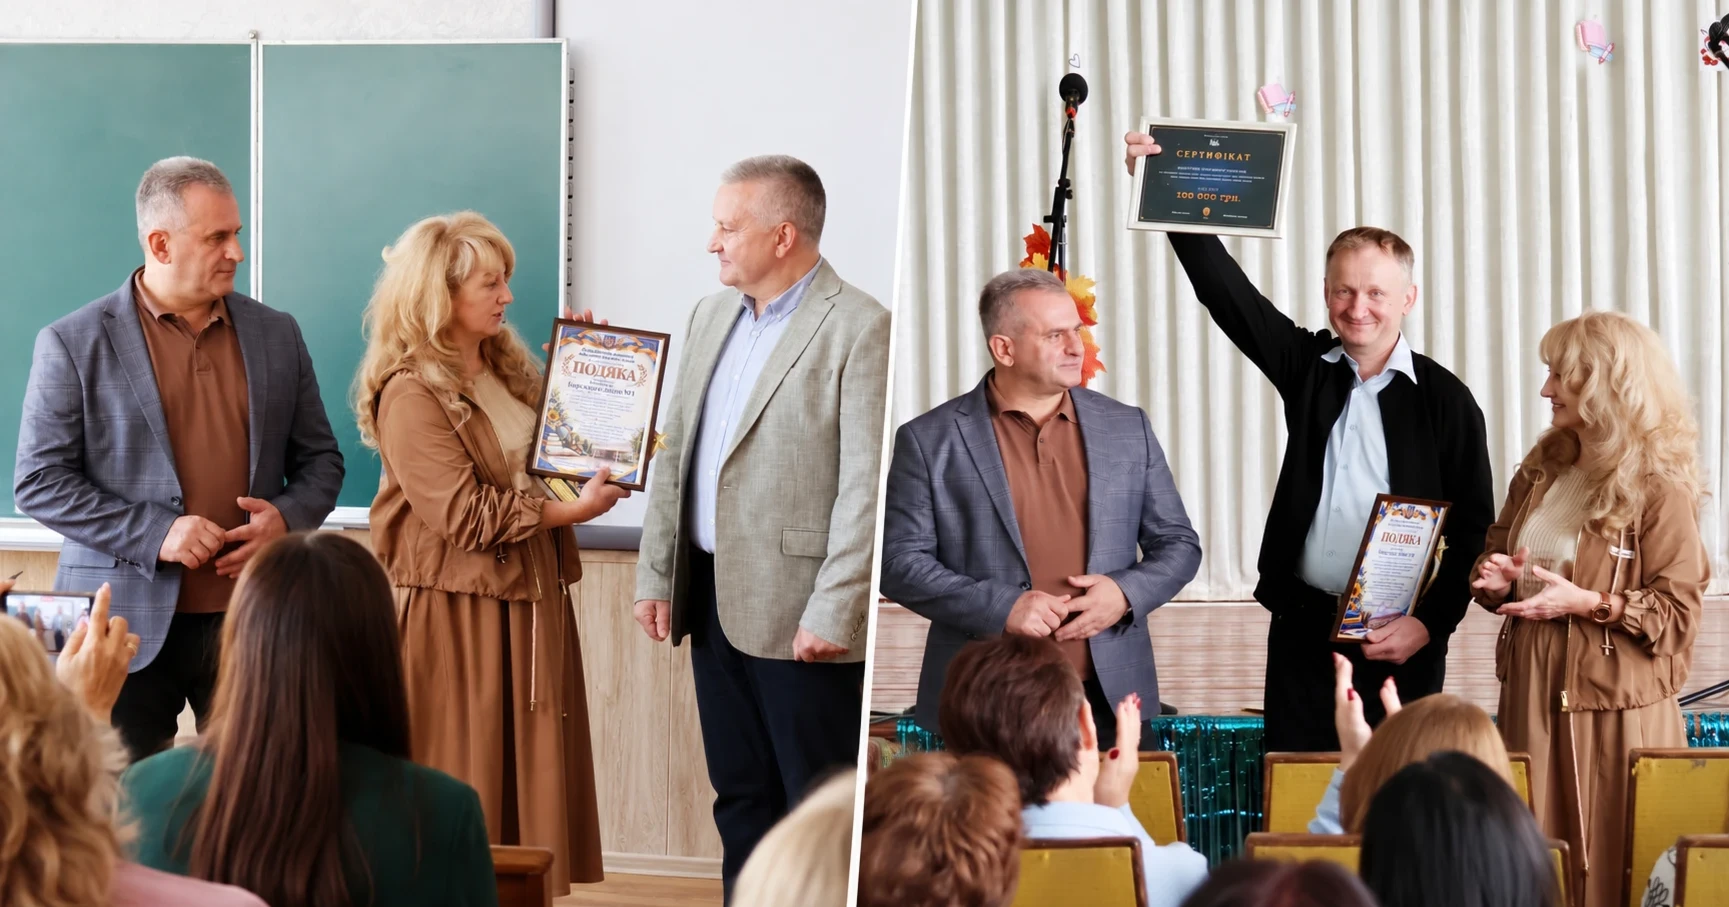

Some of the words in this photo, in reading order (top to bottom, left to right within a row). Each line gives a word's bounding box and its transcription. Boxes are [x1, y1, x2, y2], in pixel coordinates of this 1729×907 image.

[1176, 150, 1251, 161] СЕРТИФІКАТ
[1176, 191, 1194, 199] 100
[573, 360, 636, 382] ПОДЯКА
[1381, 531, 1421, 545] ПОДЯКА
